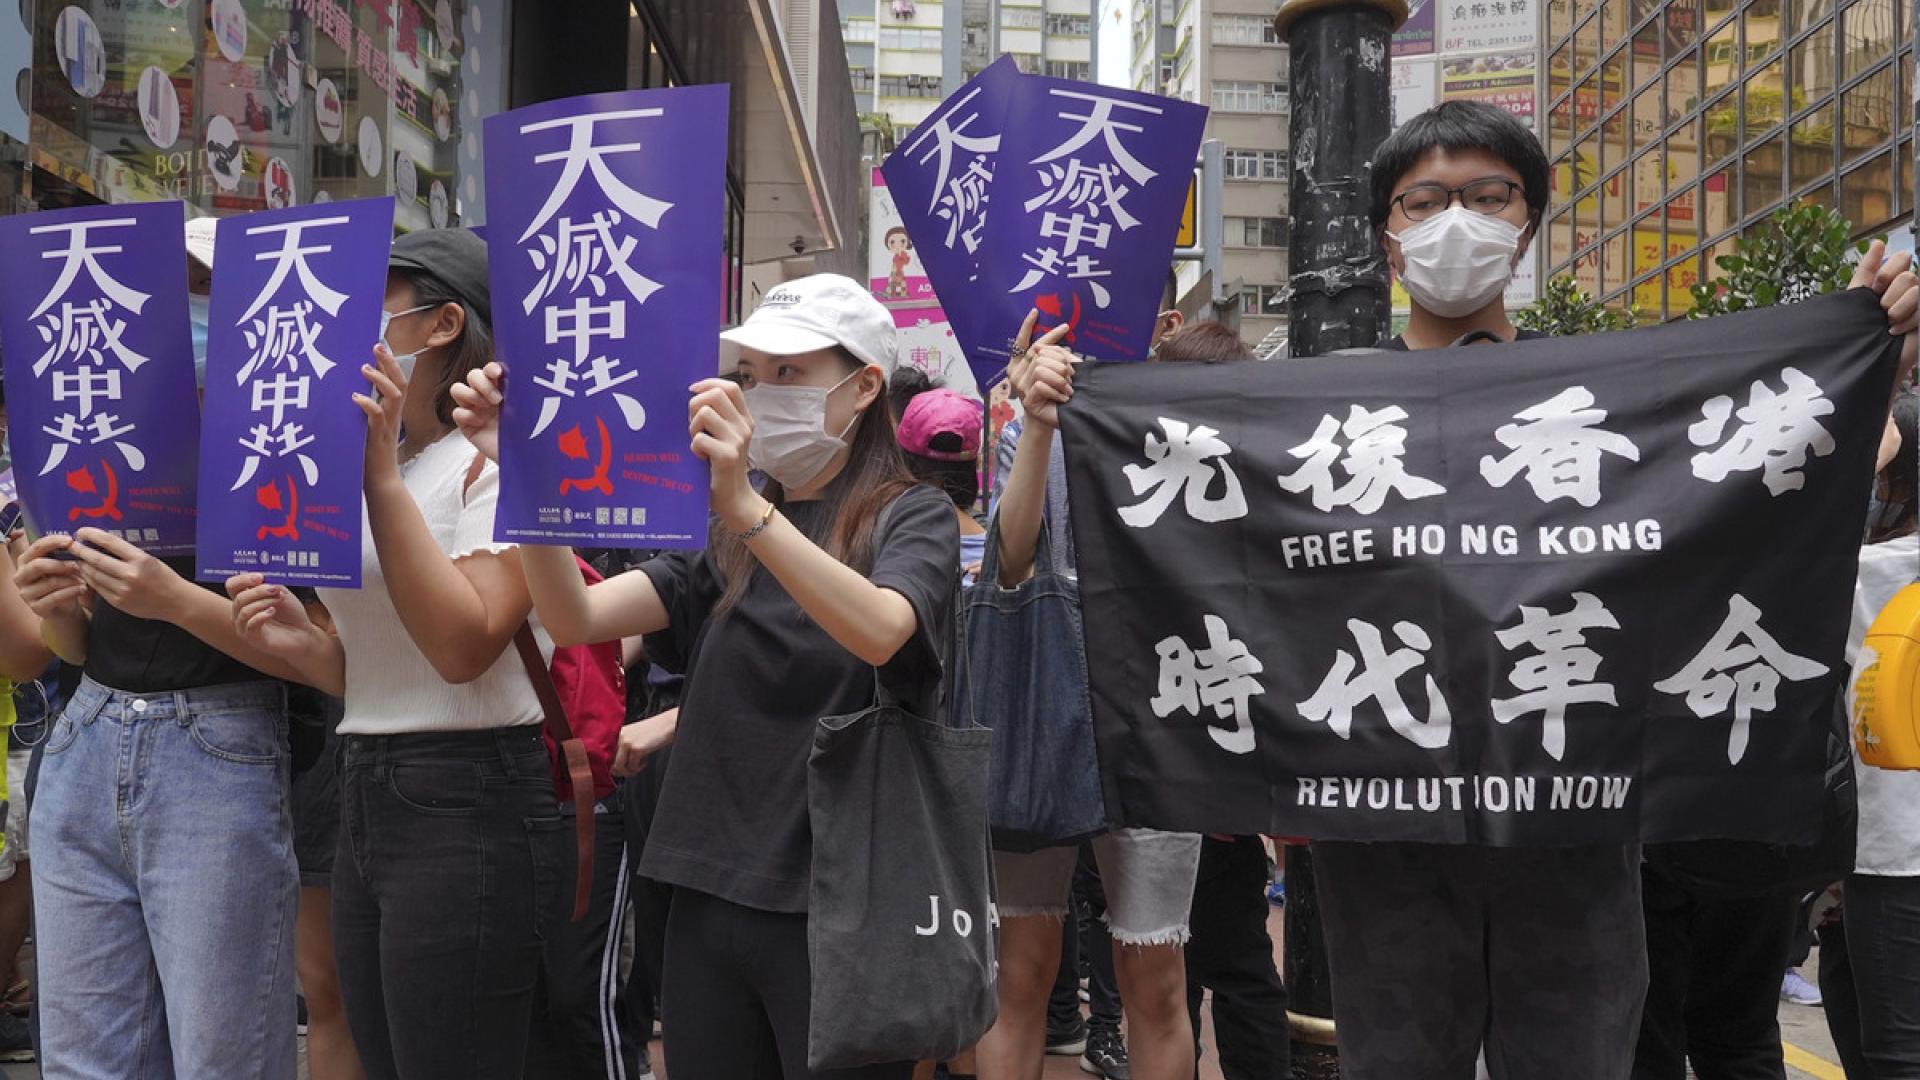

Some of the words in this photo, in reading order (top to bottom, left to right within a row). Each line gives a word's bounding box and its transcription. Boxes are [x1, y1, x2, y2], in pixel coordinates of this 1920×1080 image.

[517, 107, 675, 439] 天滅中共
[1009, 88, 1163, 309] 天滅中共
[28, 217, 153, 477] 天滅中共
[229, 216, 351, 492] 天滅中共
[1117, 366, 1836, 528] 光復香港
[1281, 528, 1375, 569] FREE
[1539, 518, 1662, 555] KONG
[1150, 591, 1831, 766] 時代革命
[1296, 774, 1536, 813] REVOLUTION
[1549, 775, 1632, 811] NOW
